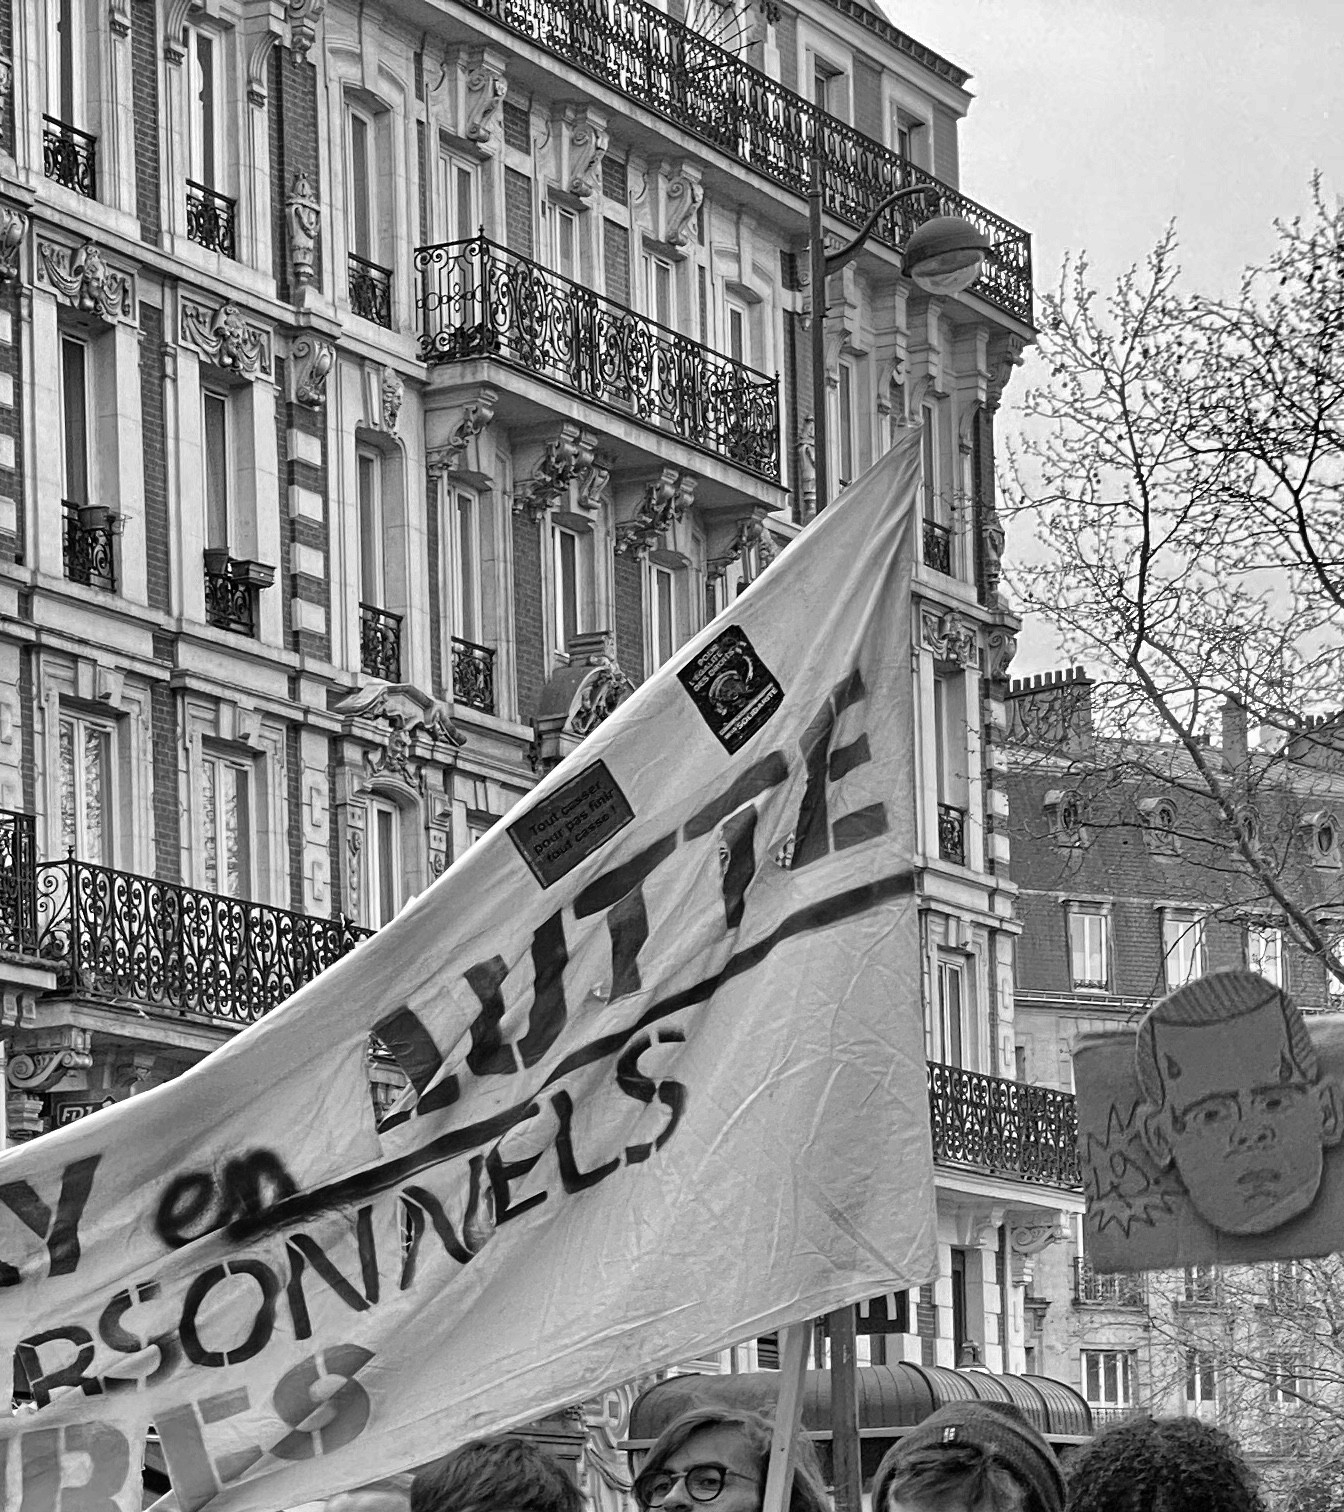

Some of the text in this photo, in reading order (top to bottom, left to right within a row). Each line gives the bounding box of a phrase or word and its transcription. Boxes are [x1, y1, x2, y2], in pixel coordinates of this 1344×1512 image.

[529, 780, 602, 836] Tout casser
[533, 789, 615, 856] pour pas finir
[546, 840, 573, 863] tout
[370, 666, 888, 1132] LUTTE
